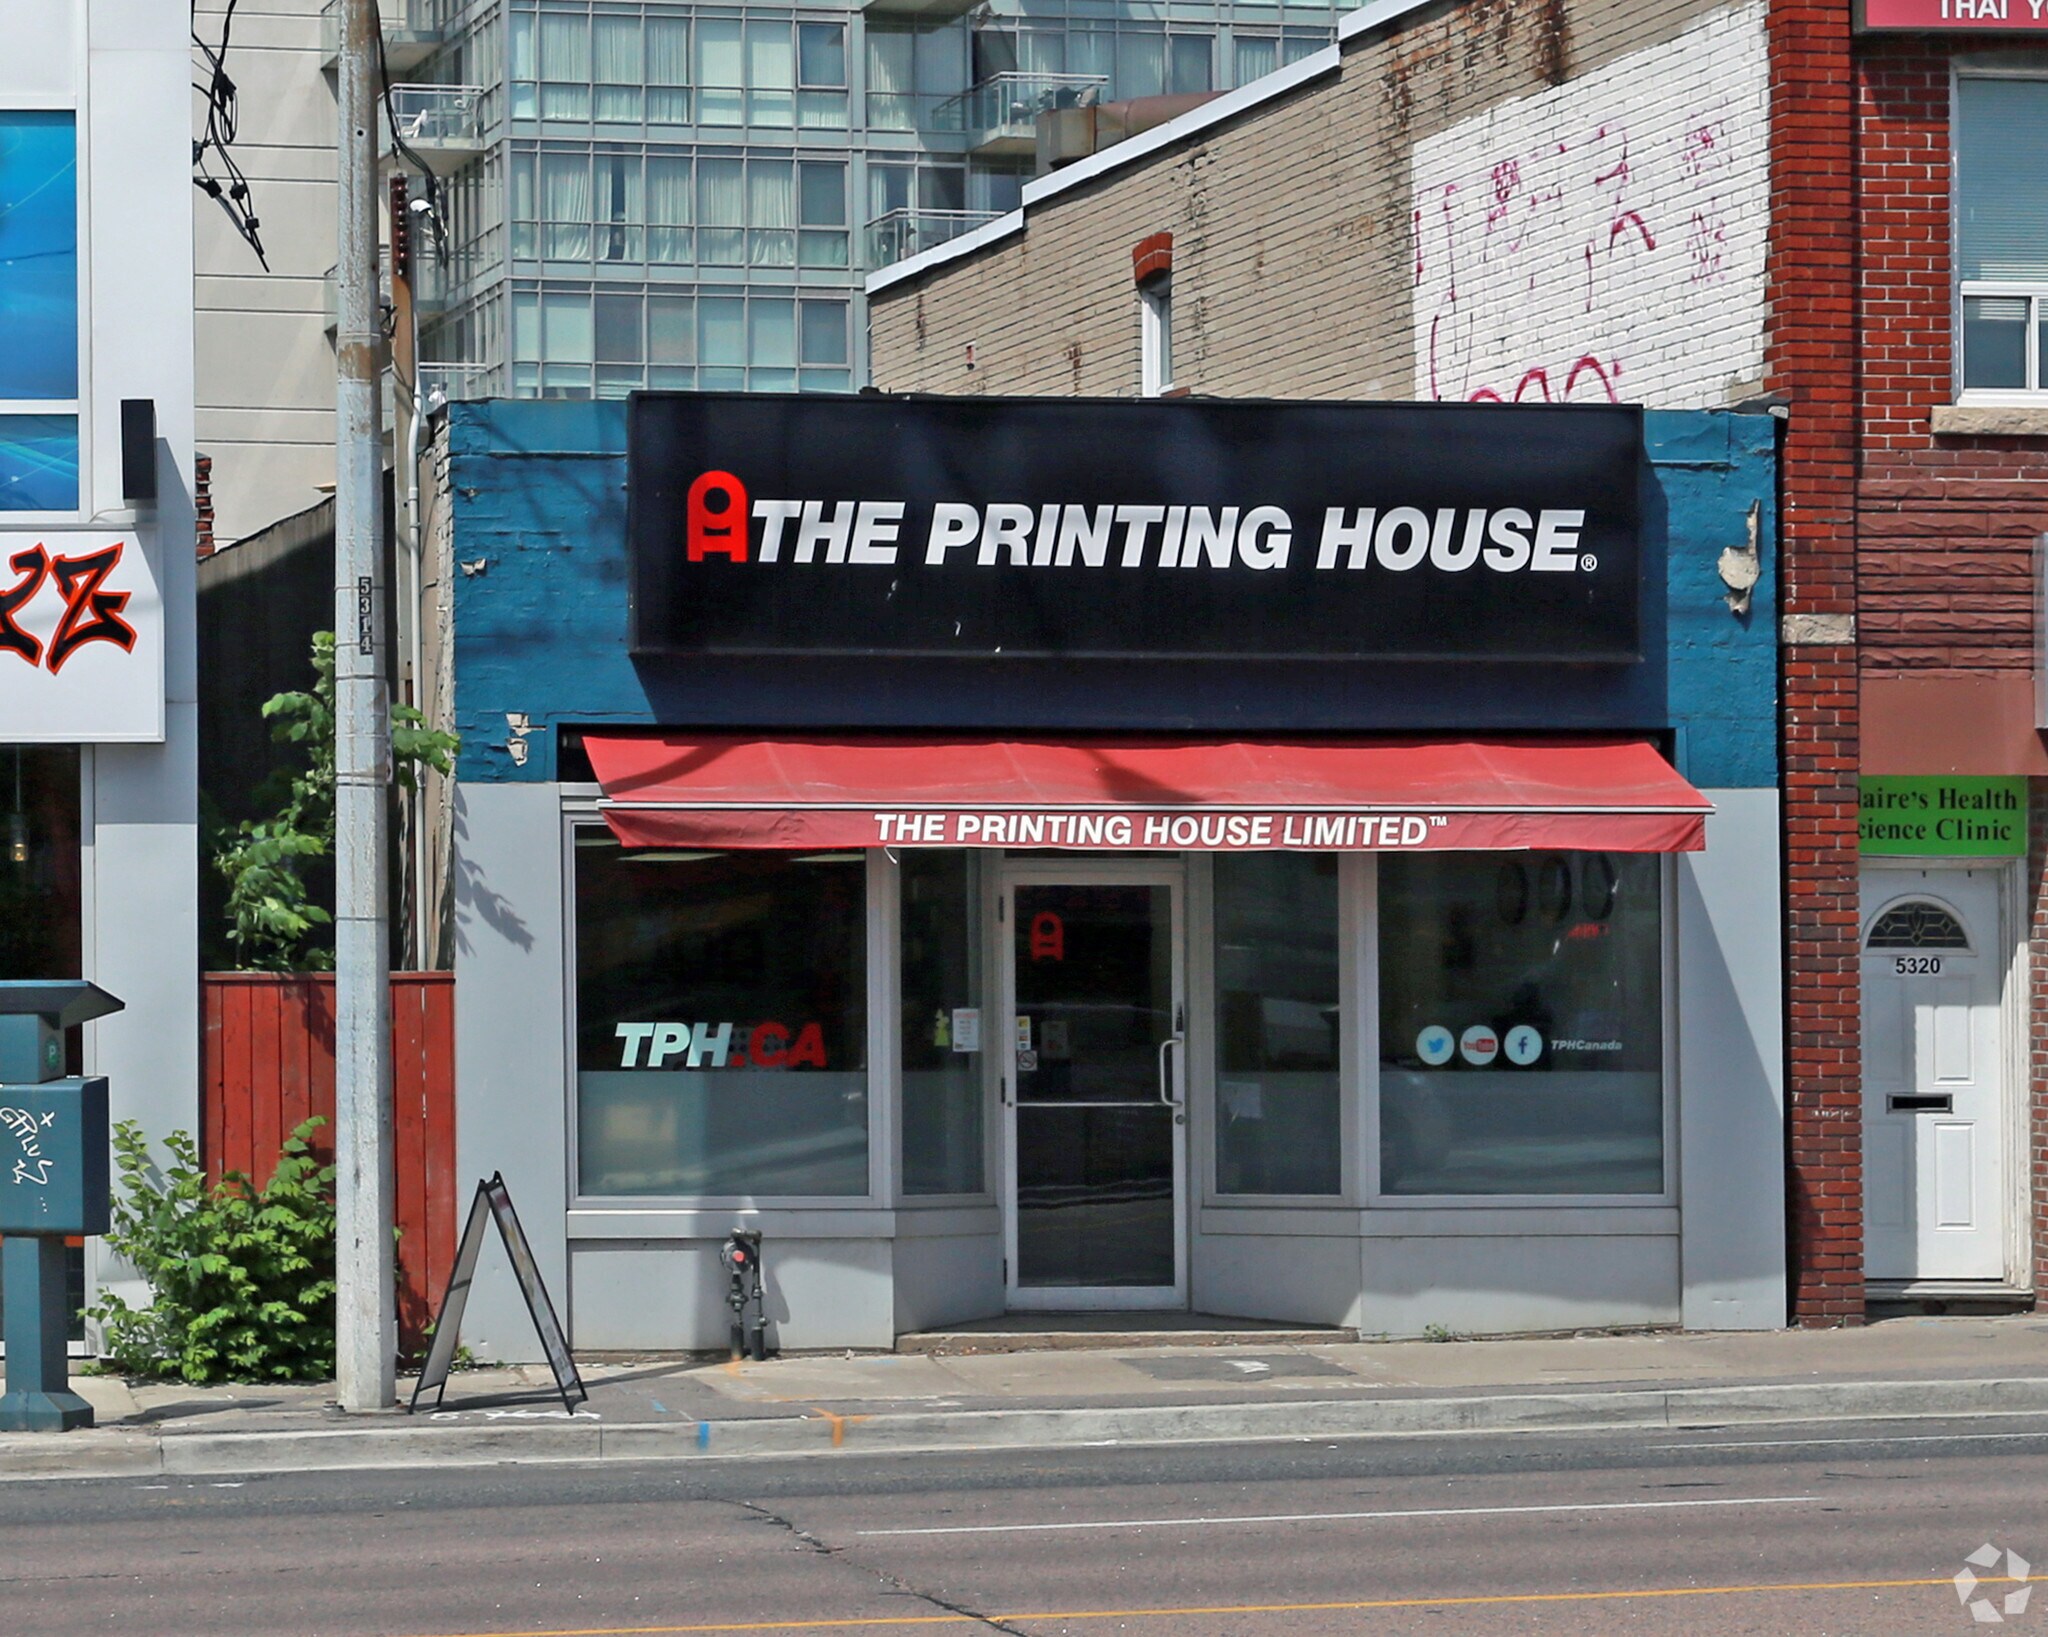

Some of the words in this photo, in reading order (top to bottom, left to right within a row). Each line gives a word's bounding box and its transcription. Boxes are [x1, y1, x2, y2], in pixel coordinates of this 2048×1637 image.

[2026, 0, 2048, 20] Y
[752, 500, 905, 565] THE
[925, 503, 1292, 571] PRINTING
[360, 578, 372, 653] 5314
[1939, 787, 2018, 811] Health
[874, 813, 946, 841] THE
[956, 814, 1132, 845] PRINTING
[1143, 815, 1273, 846] HOUSE
[1859, 817, 1927, 840] cience
[1936, 818, 2012, 841] Clinic
[1896, 957, 1941, 974] 5320
[615, 1020, 828, 1068] TPH.CA
